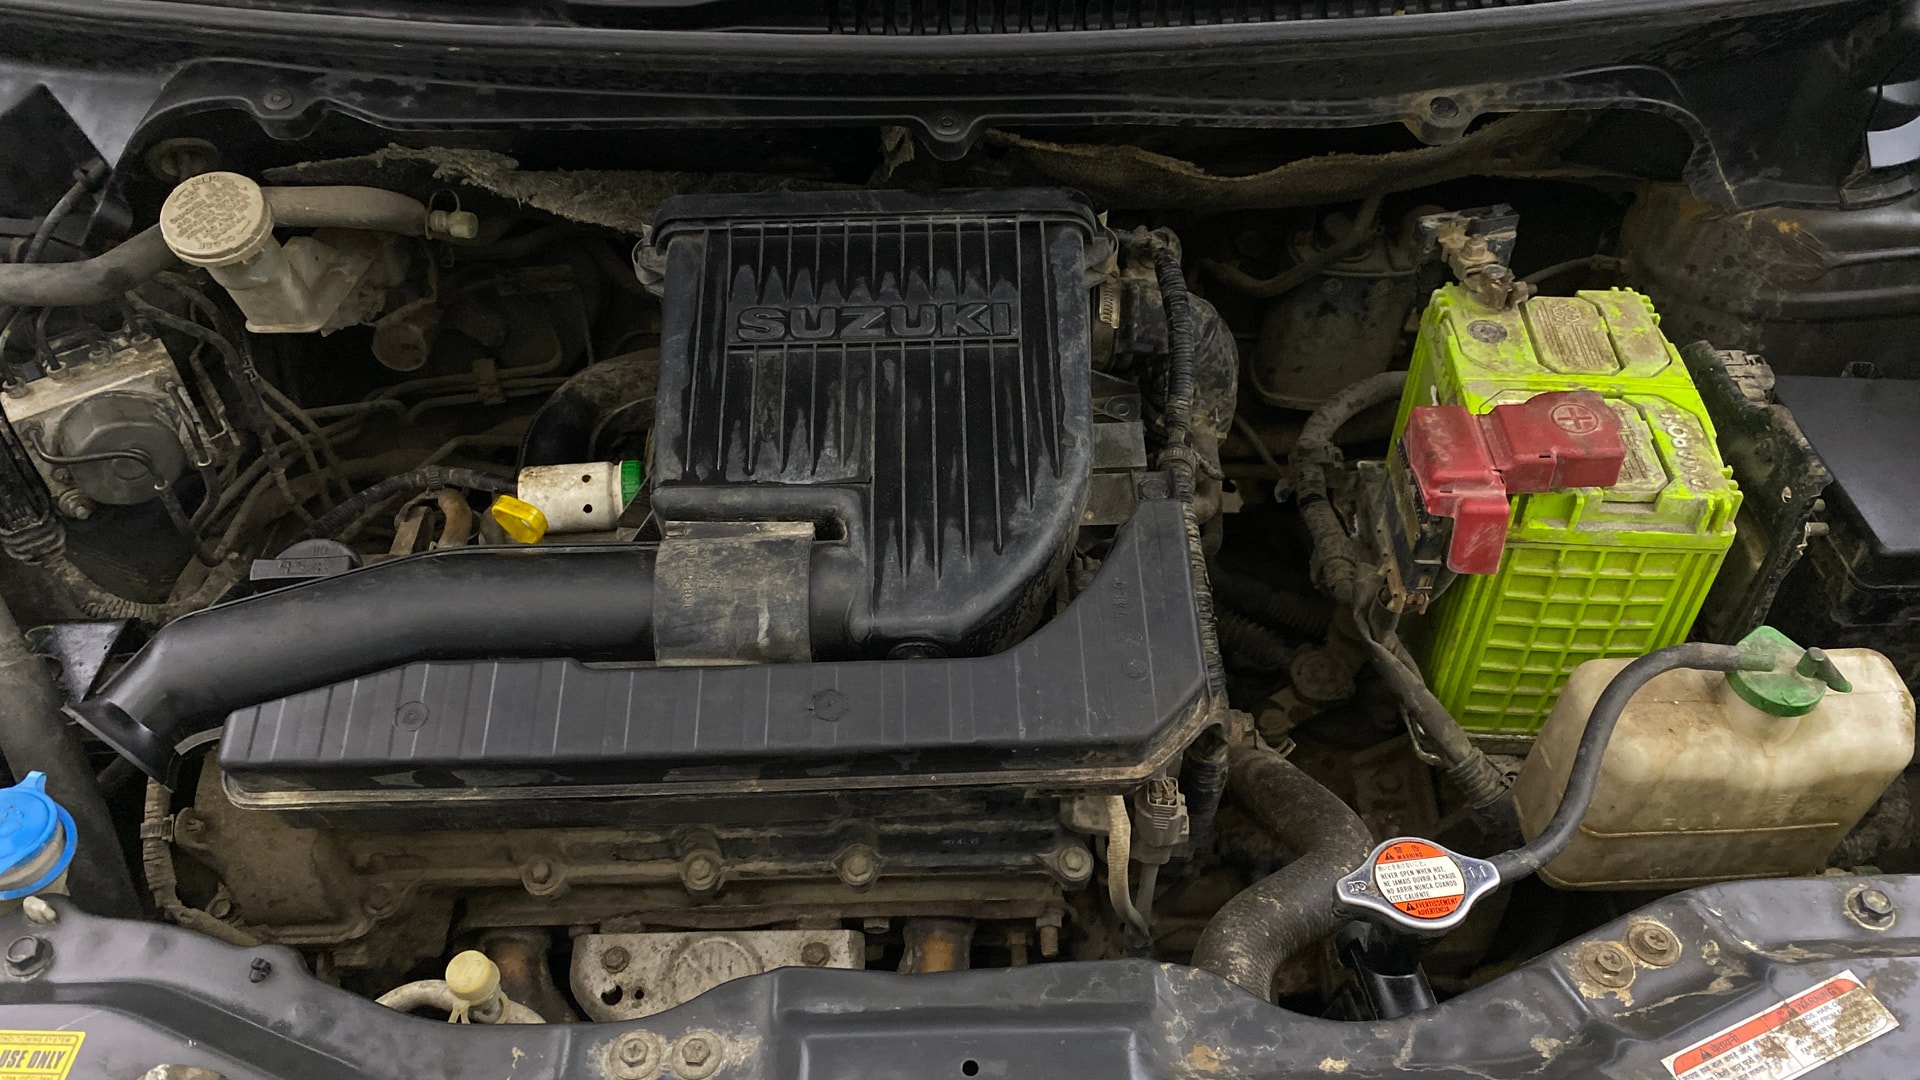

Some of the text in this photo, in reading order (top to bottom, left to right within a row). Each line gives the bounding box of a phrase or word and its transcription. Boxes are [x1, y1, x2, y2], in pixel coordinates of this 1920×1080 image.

[737, 302, 1011, 341] SUZUKI
[1380, 872, 1398, 880] NEVER
[1392, 878, 1412, 886] JAMAIS
[1412, 875, 1431, 884] OUVRIR
[1396, 885, 1413, 893] ABRIR
[1414, 882, 1433, 890] NUNCA
[1435, 880, 1458, 888] CUANDO
[1415, 897, 1458, 909] AVERTISSEMENT
[1796, 987, 1836, 1011] WARNING
[0, 1050, 67, 1069] USE ONLY
